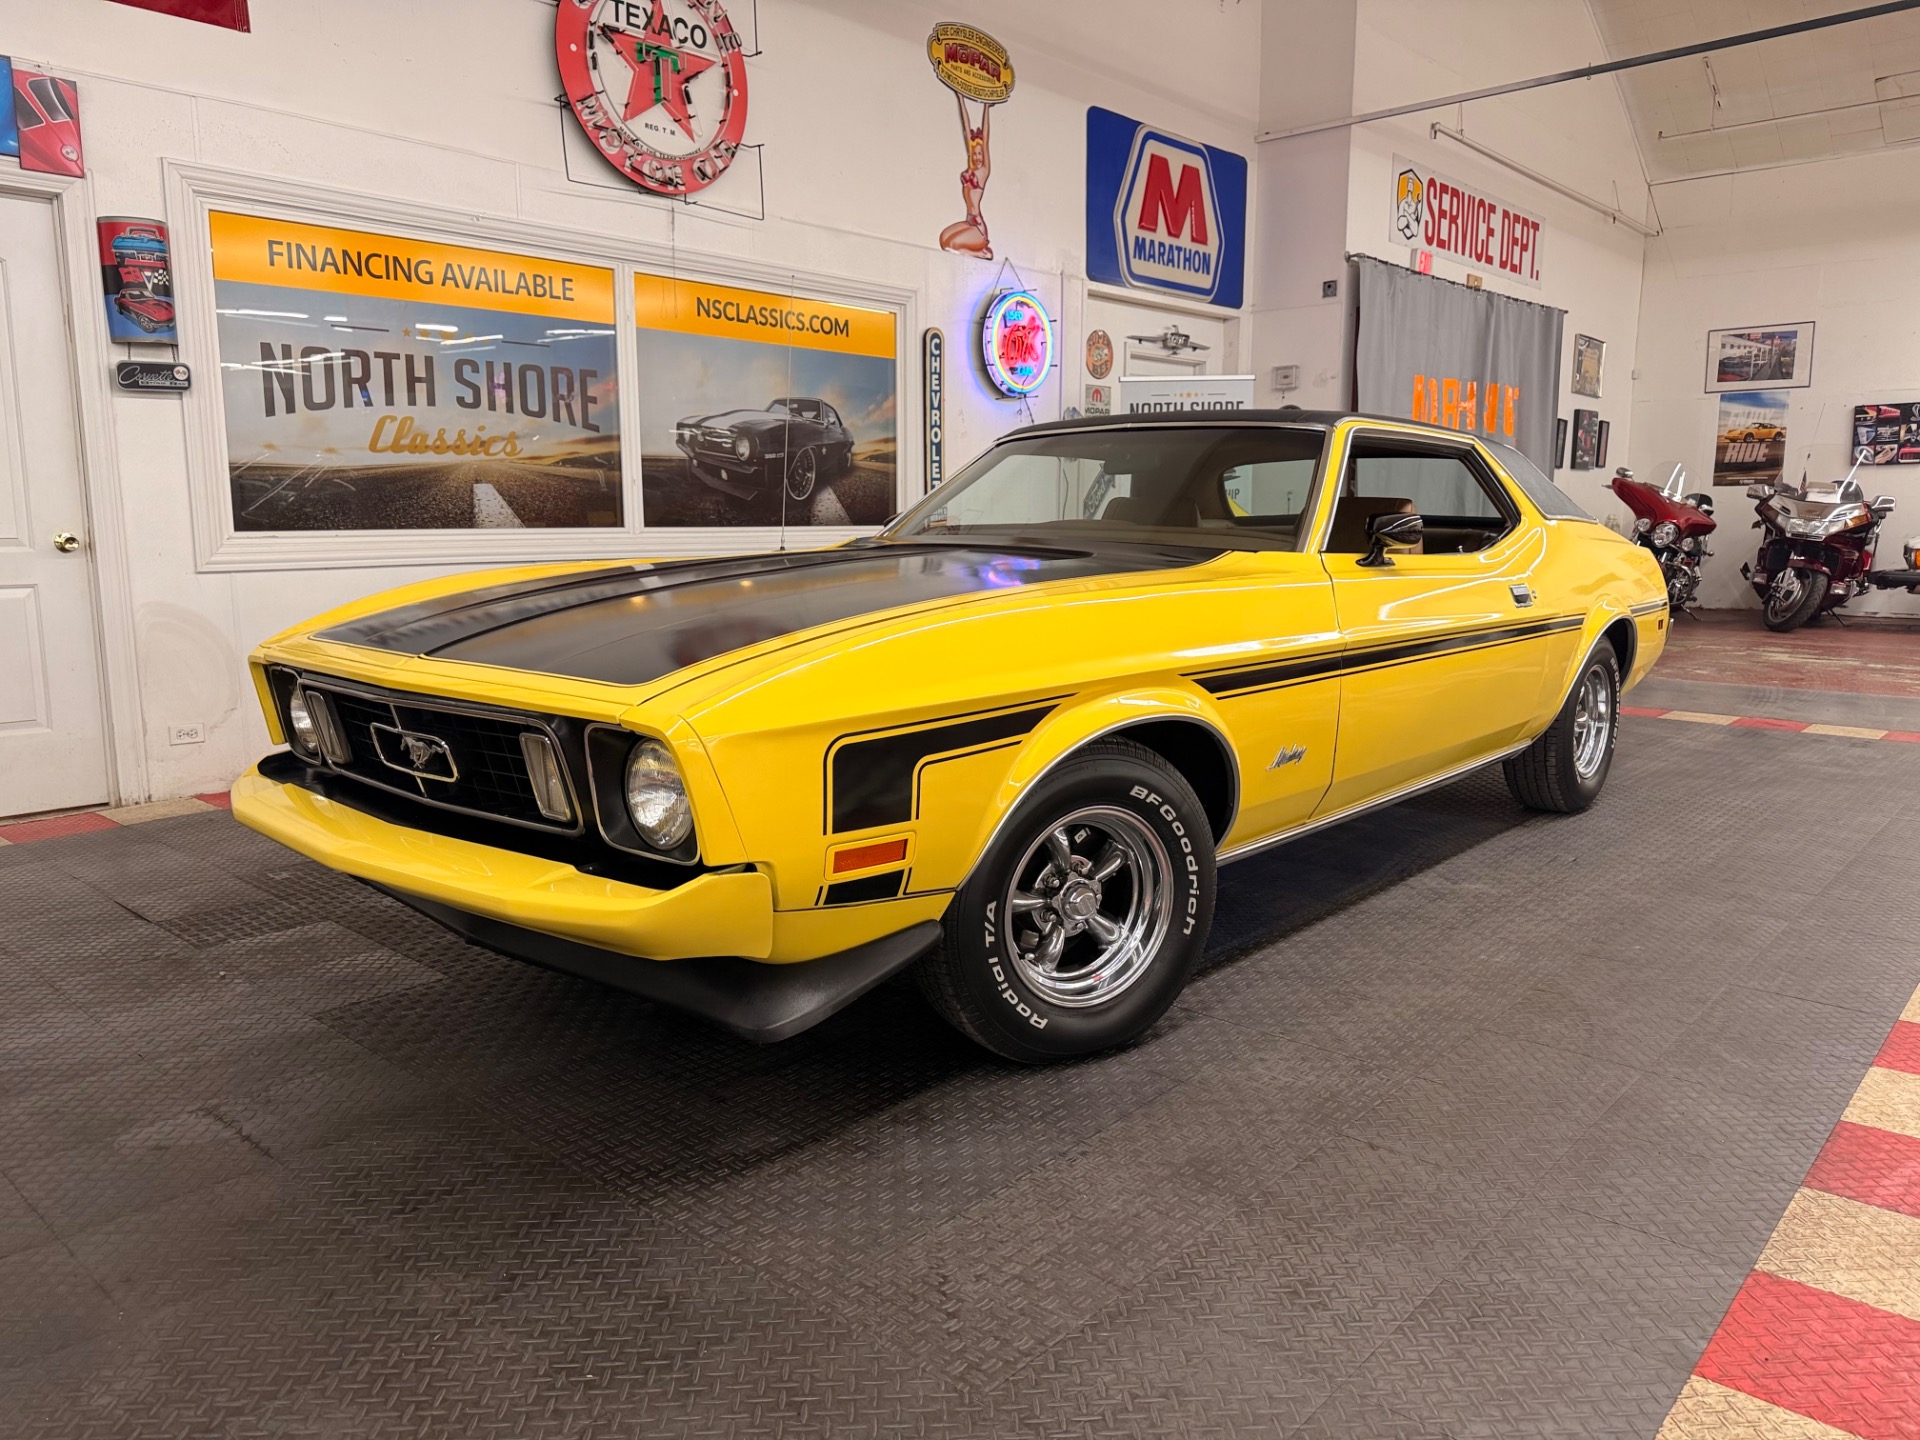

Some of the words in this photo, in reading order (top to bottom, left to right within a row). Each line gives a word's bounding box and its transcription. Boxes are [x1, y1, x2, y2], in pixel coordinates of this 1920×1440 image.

[609, 0, 707, 49] TEXACO
[944, 42, 1001, 83] MOPAR
[1138, 153, 1209, 247] M
[1424, 177, 1497, 266] SERVICE
[1499, 208, 1541, 281] DEPT.
[268, 239, 434, 285] FINANCING
[441, 262, 575, 302] AVAILABLE
[1133, 236, 1212, 276] MARATHON
[696, 297, 850, 338] NSCLASSICS.COM
[119, 365, 176, 385] Corvette
[259, 341, 437, 418] NORTH
[454, 358, 601, 433] SHORE
[368, 414, 525, 458] Classics
[930, 338, 942, 491] CHEVROLET
[1724, 442, 1770, 463] RIDE
[1129, 785, 1200, 935] BFGoodrich
[985, 901, 997, 948] T/A
[988, 957, 1048, 1029] Radial
